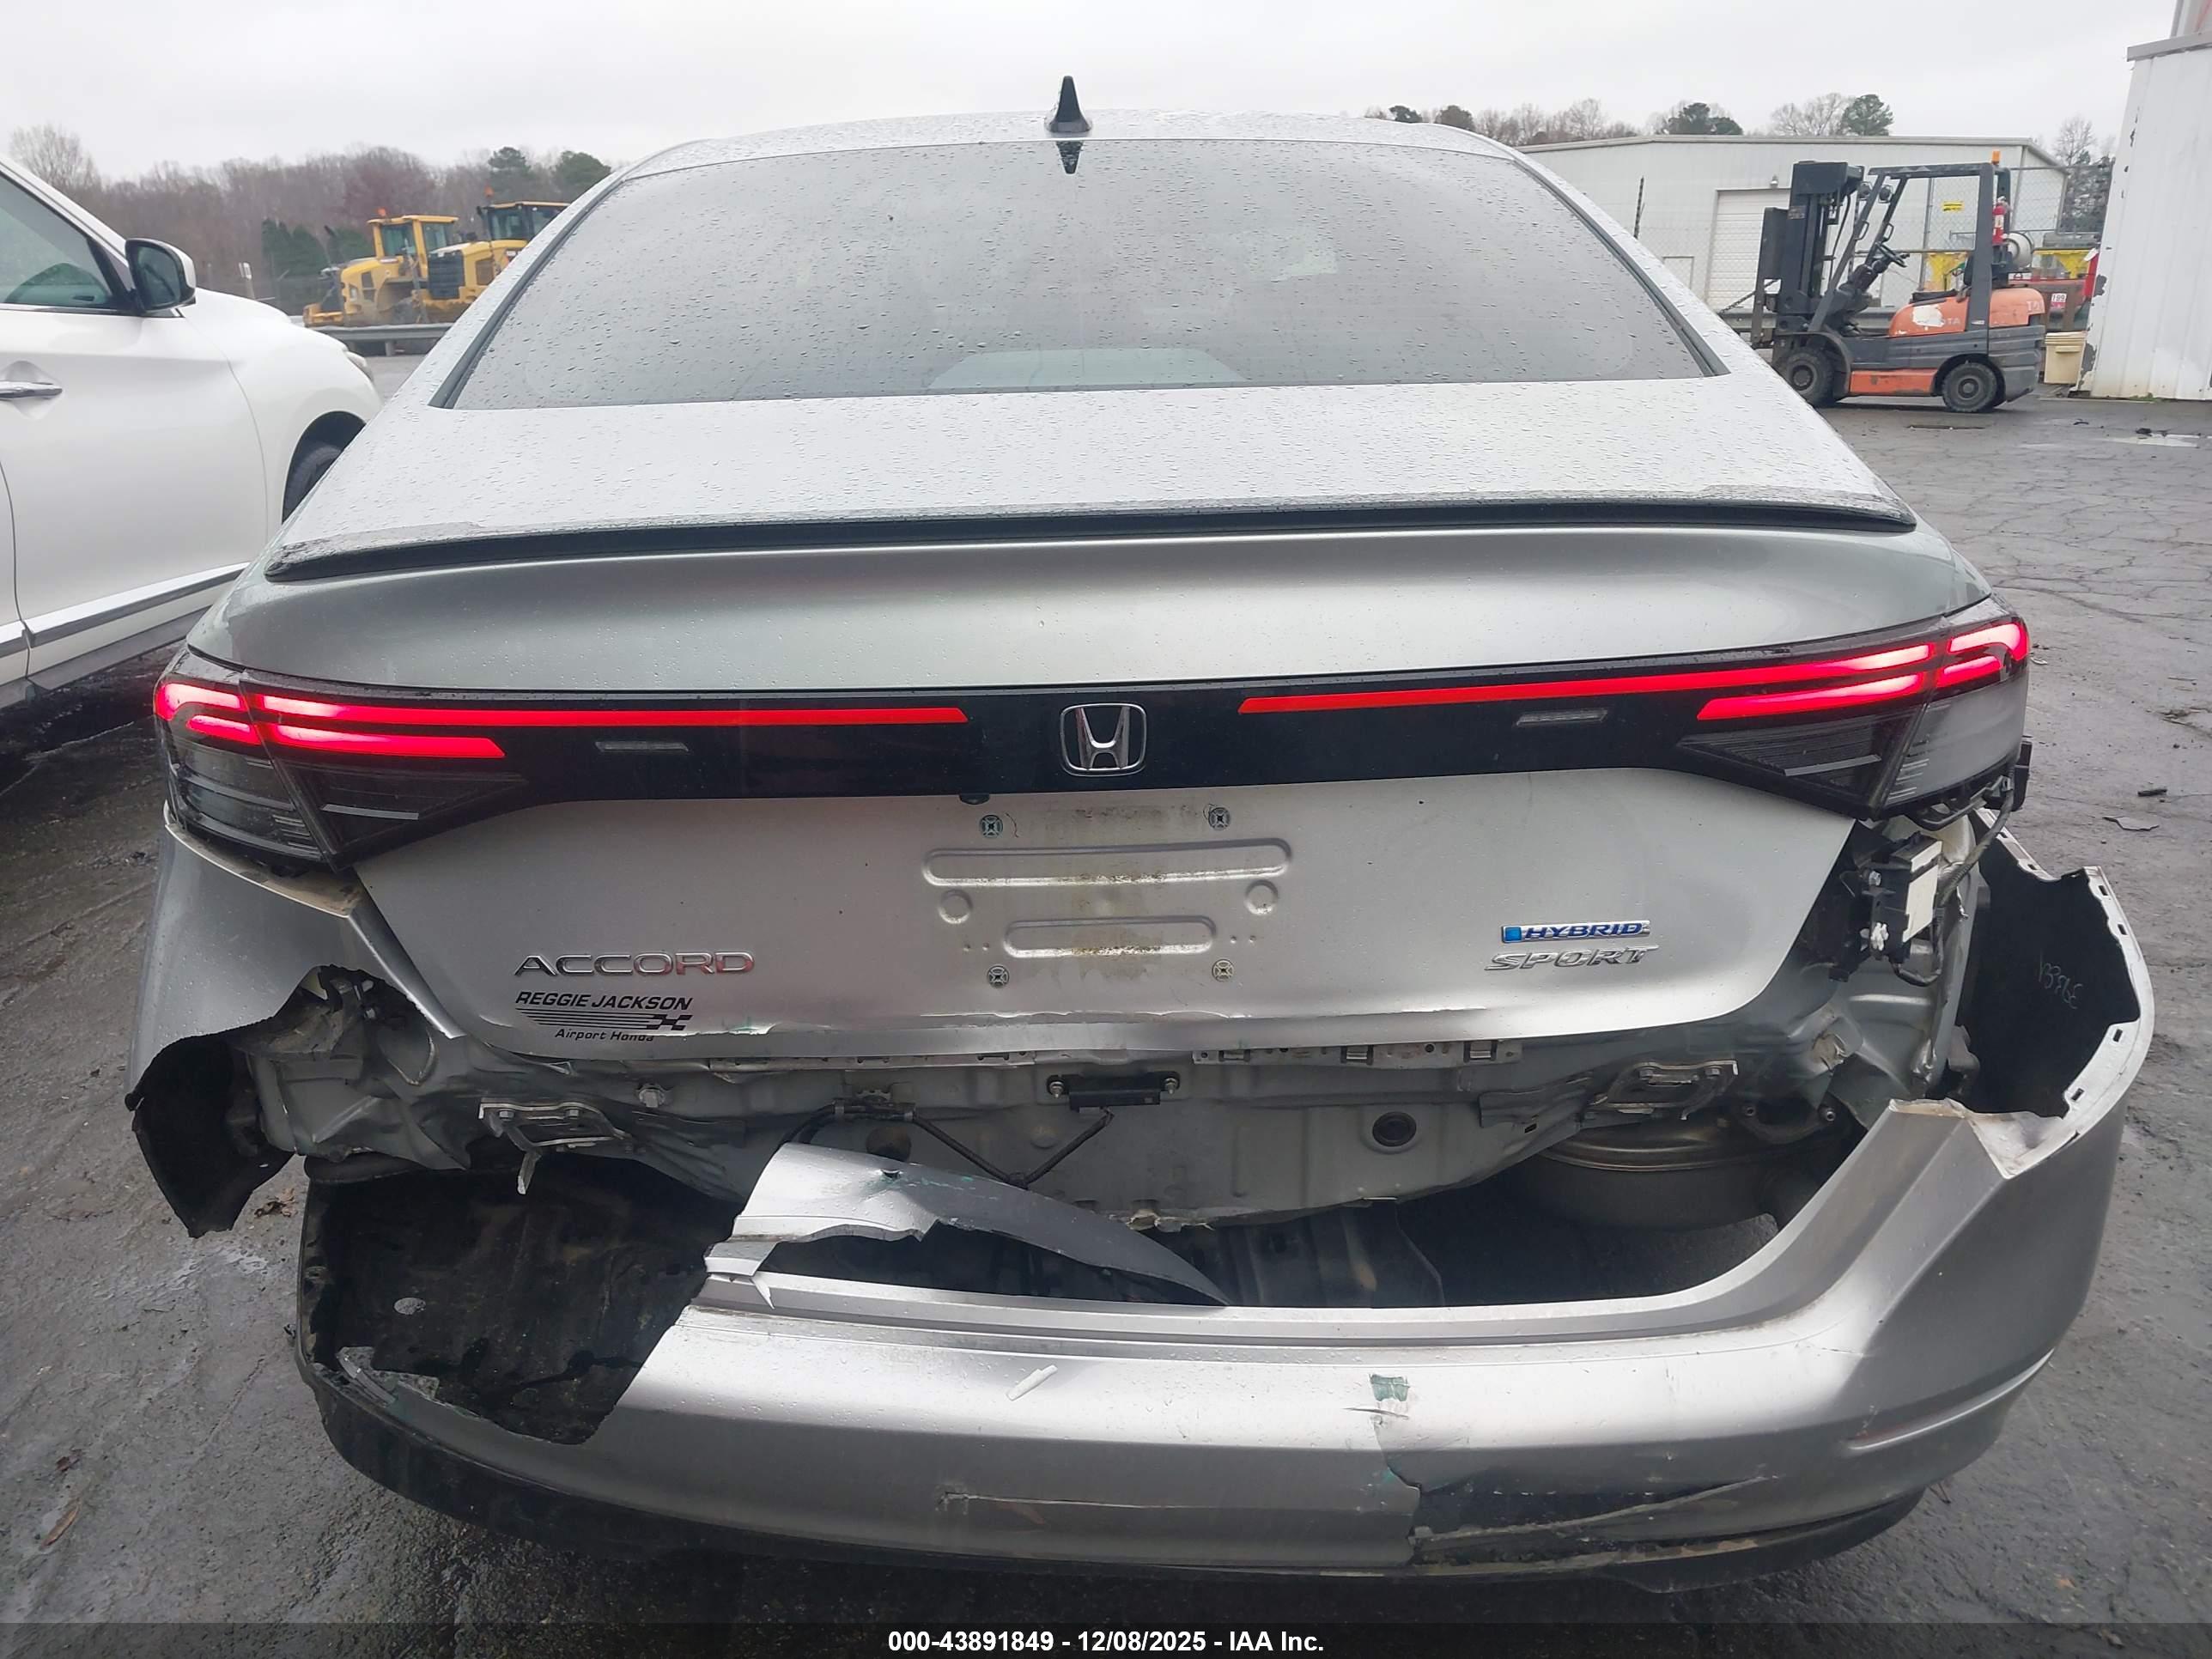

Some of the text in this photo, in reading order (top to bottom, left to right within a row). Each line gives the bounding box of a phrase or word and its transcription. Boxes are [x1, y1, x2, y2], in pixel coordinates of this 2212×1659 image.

[1524, 921, 1644, 939] HYBRID
[514, 951, 756, 977] ACCORD
[1483, 945, 1659, 971] SPORT
[514, 990, 694, 1011] REGGIE JACKSON
[554, 1028, 608, 1041] Airport
